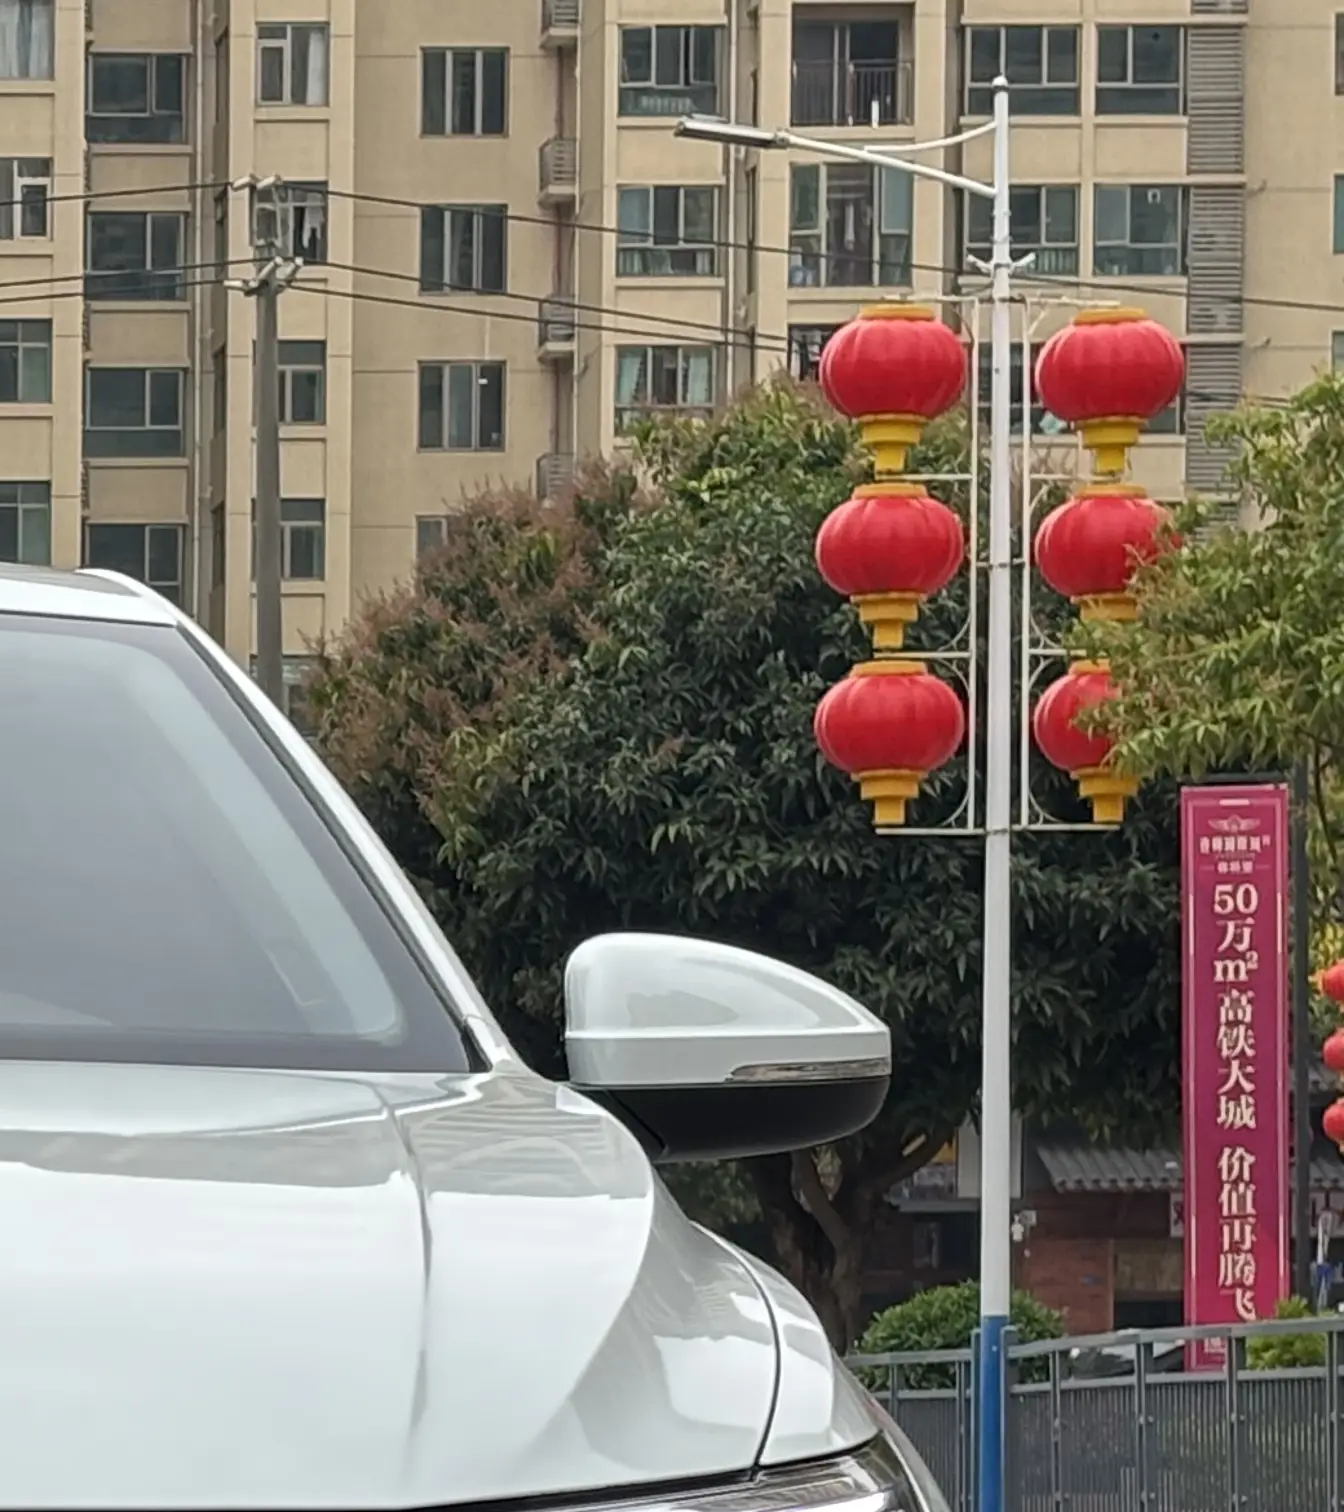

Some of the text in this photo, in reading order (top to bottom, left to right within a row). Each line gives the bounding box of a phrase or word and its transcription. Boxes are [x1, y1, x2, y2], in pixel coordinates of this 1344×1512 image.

[1218, 1147, 1257, 1321] 价值再腾飞
